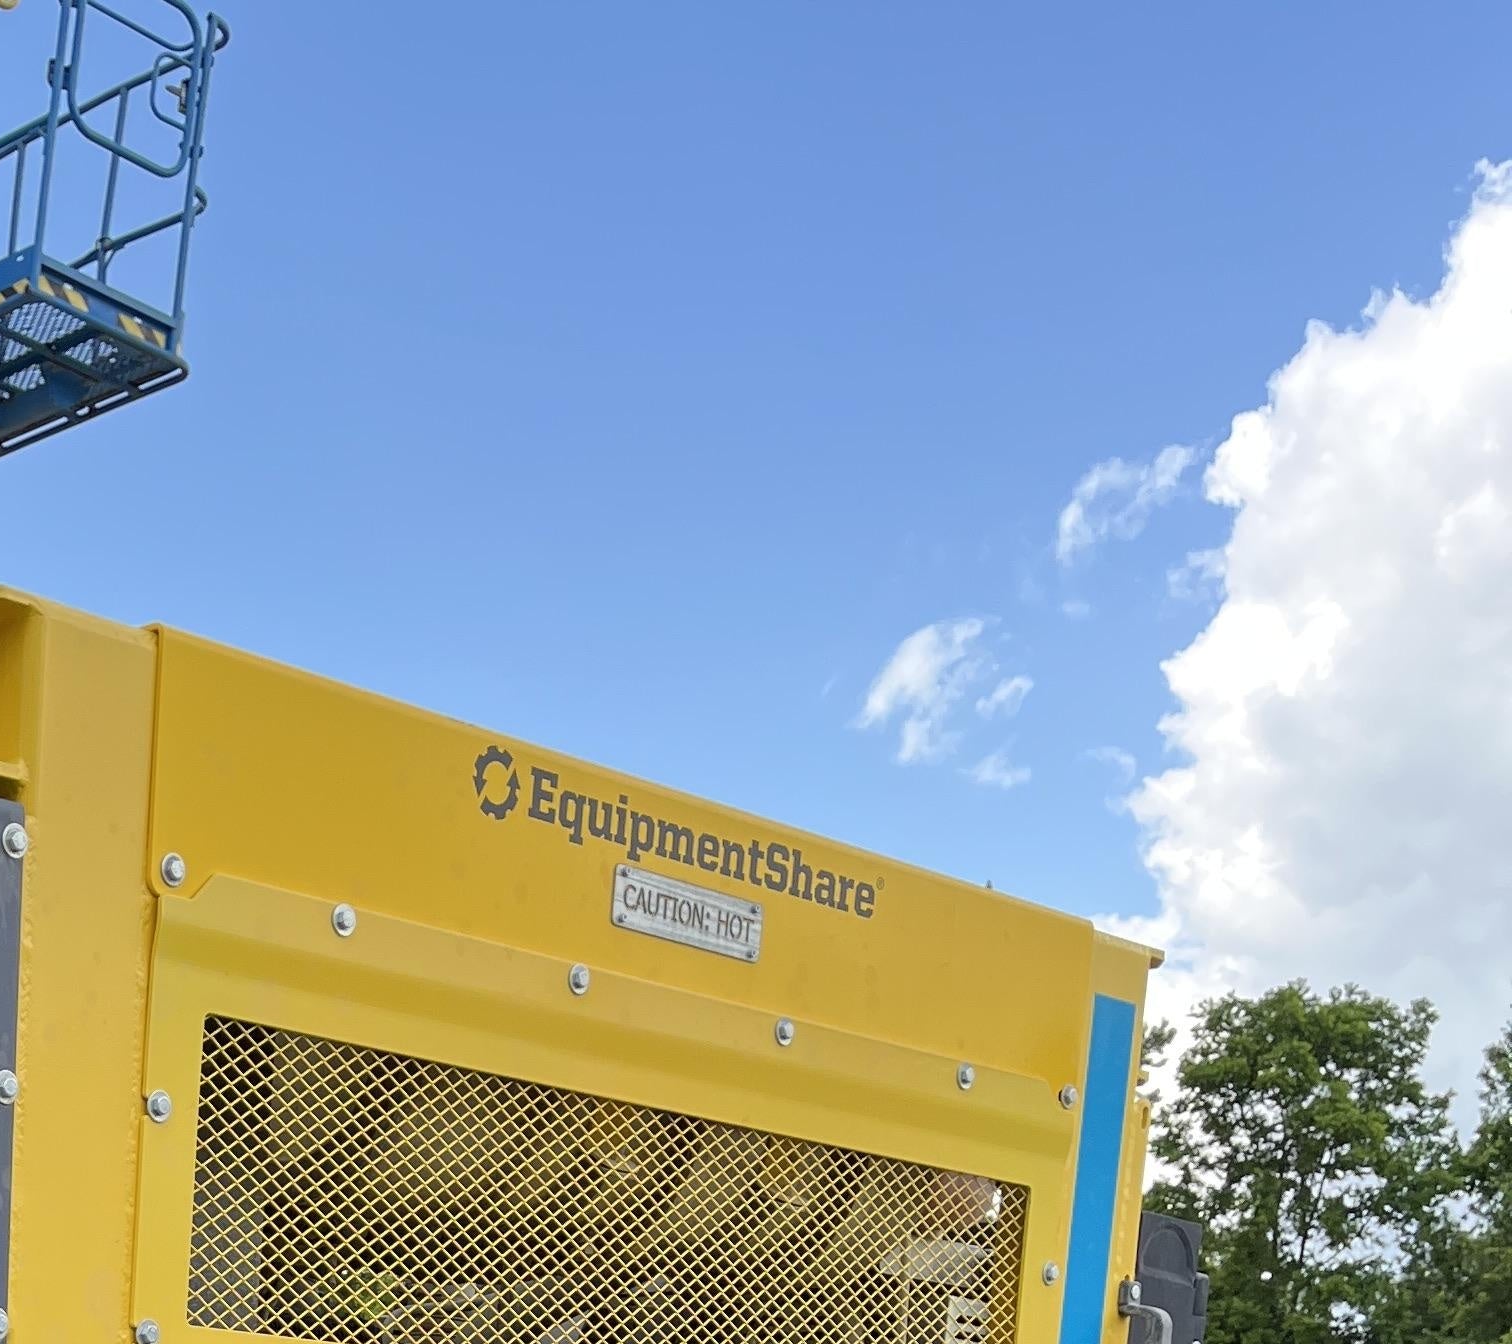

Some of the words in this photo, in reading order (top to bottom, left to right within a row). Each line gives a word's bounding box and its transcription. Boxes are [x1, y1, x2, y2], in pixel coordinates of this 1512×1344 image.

[528, 766, 876, 918] EquipmentShare
[623, 884, 711, 932] CAUTION:
[716, 909, 755, 943] HOT
